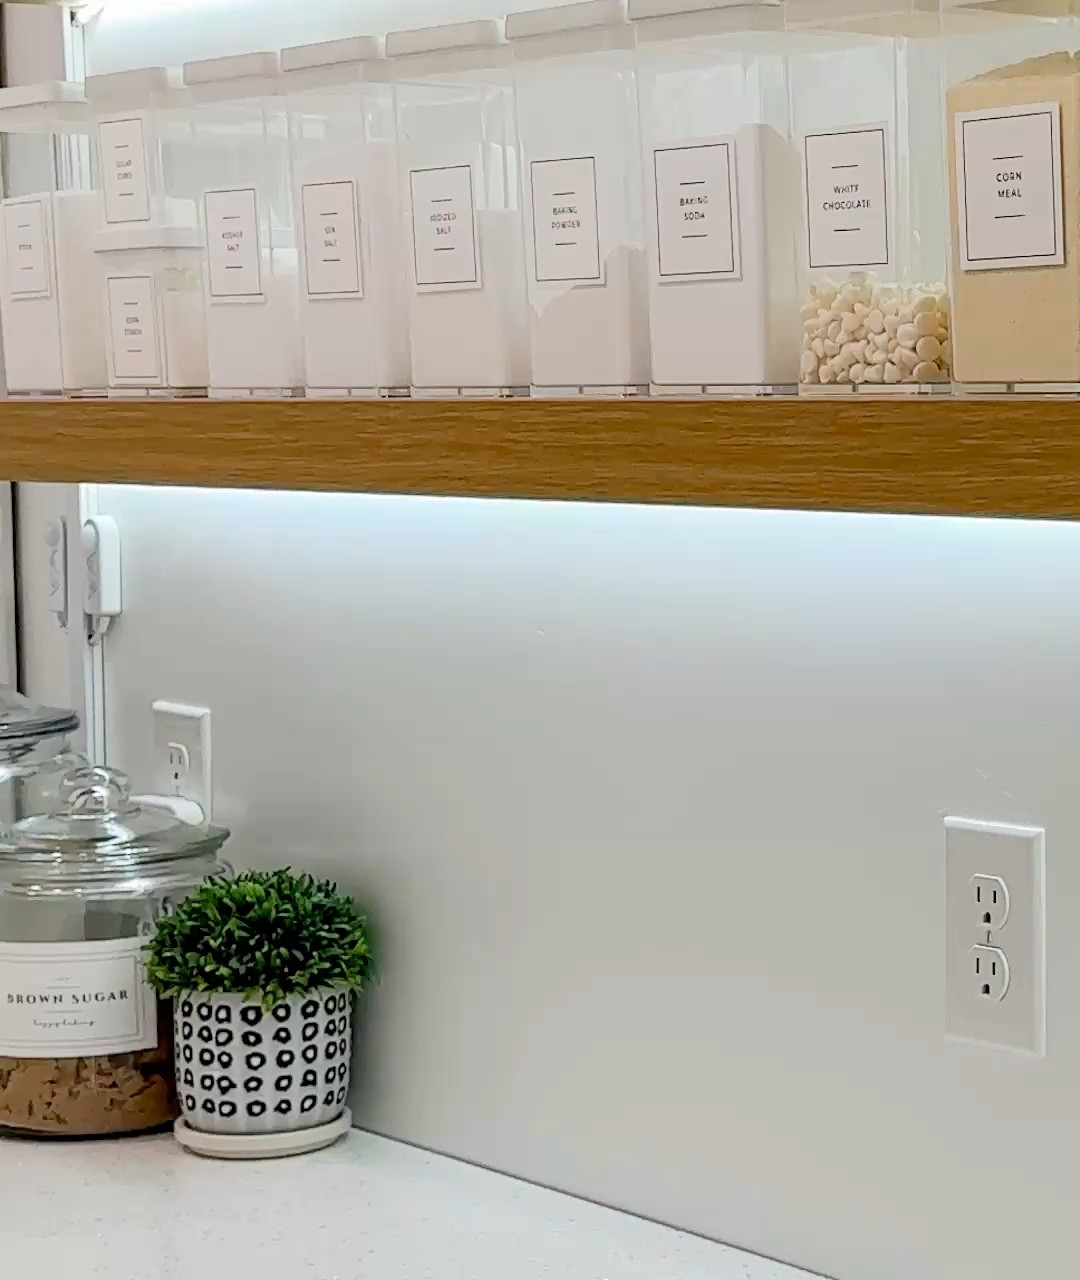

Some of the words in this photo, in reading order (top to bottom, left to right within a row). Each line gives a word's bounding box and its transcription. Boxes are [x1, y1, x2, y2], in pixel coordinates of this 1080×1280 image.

[996, 172, 1021, 182] CORN
[834, 184, 859, 194] WHITE
[998, 189, 1021, 198] MEAL
[680, 196, 708, 206] BAKING
[822, 198, 871, 211] CHOCOLATE
[553, 207, 577, 215] BAKING
[684, 212, 705, 220] SODA
[552, 220, 580, 229] POWDER
[8, 994, 62, 1004] BROWN
[71, 988, 129, 1004] SUGAR
